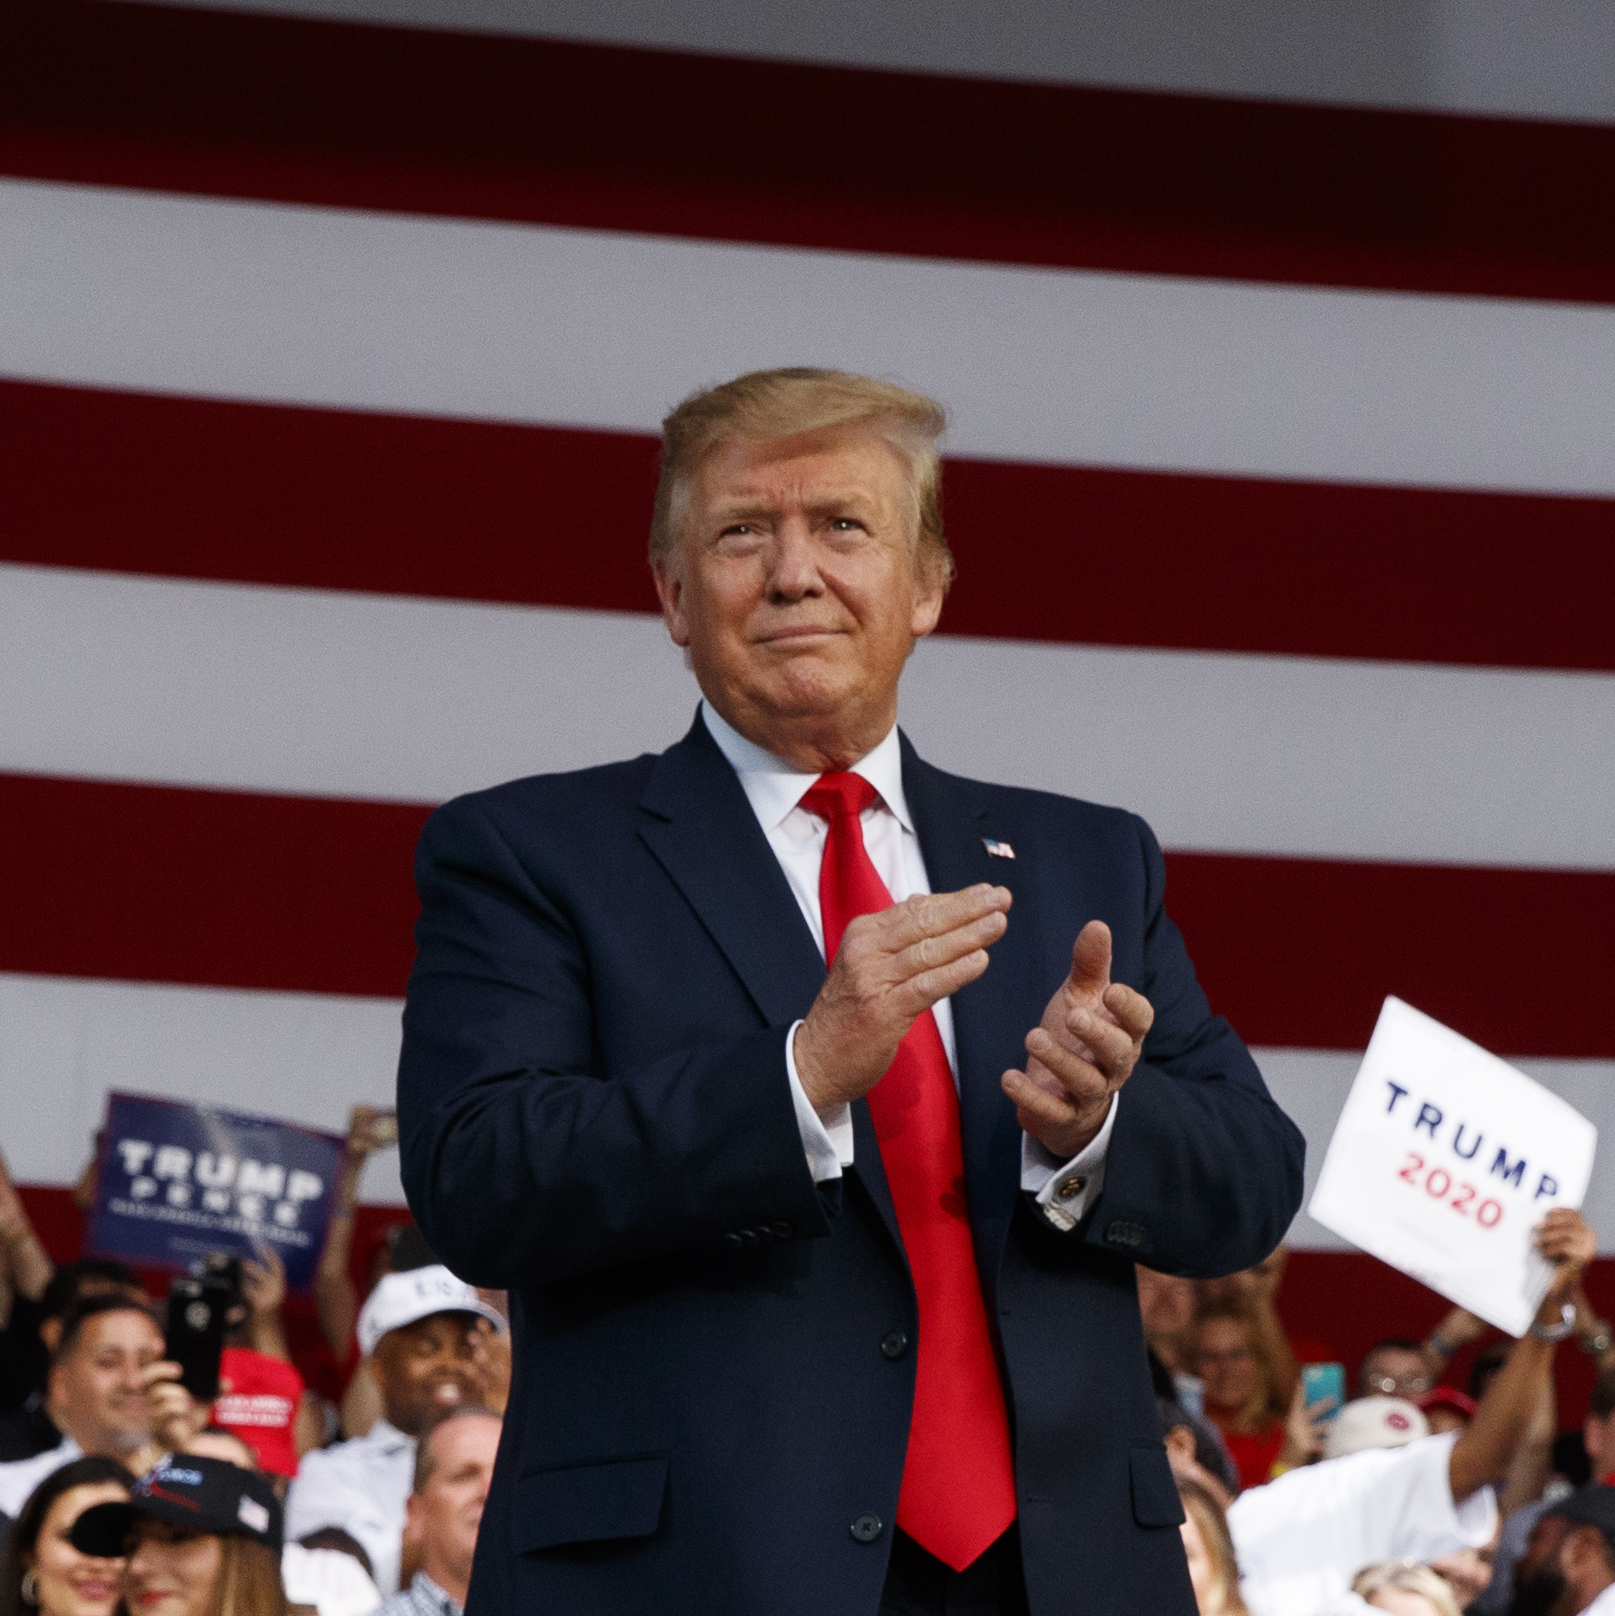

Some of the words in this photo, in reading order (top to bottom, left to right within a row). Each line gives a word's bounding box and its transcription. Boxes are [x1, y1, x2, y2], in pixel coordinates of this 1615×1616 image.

[117, 1138, 324, 1201] TRUMP
[1386, 1081, 1559, 1199] TRUMP
[1398, 1151, 1504, 1229] 2020
